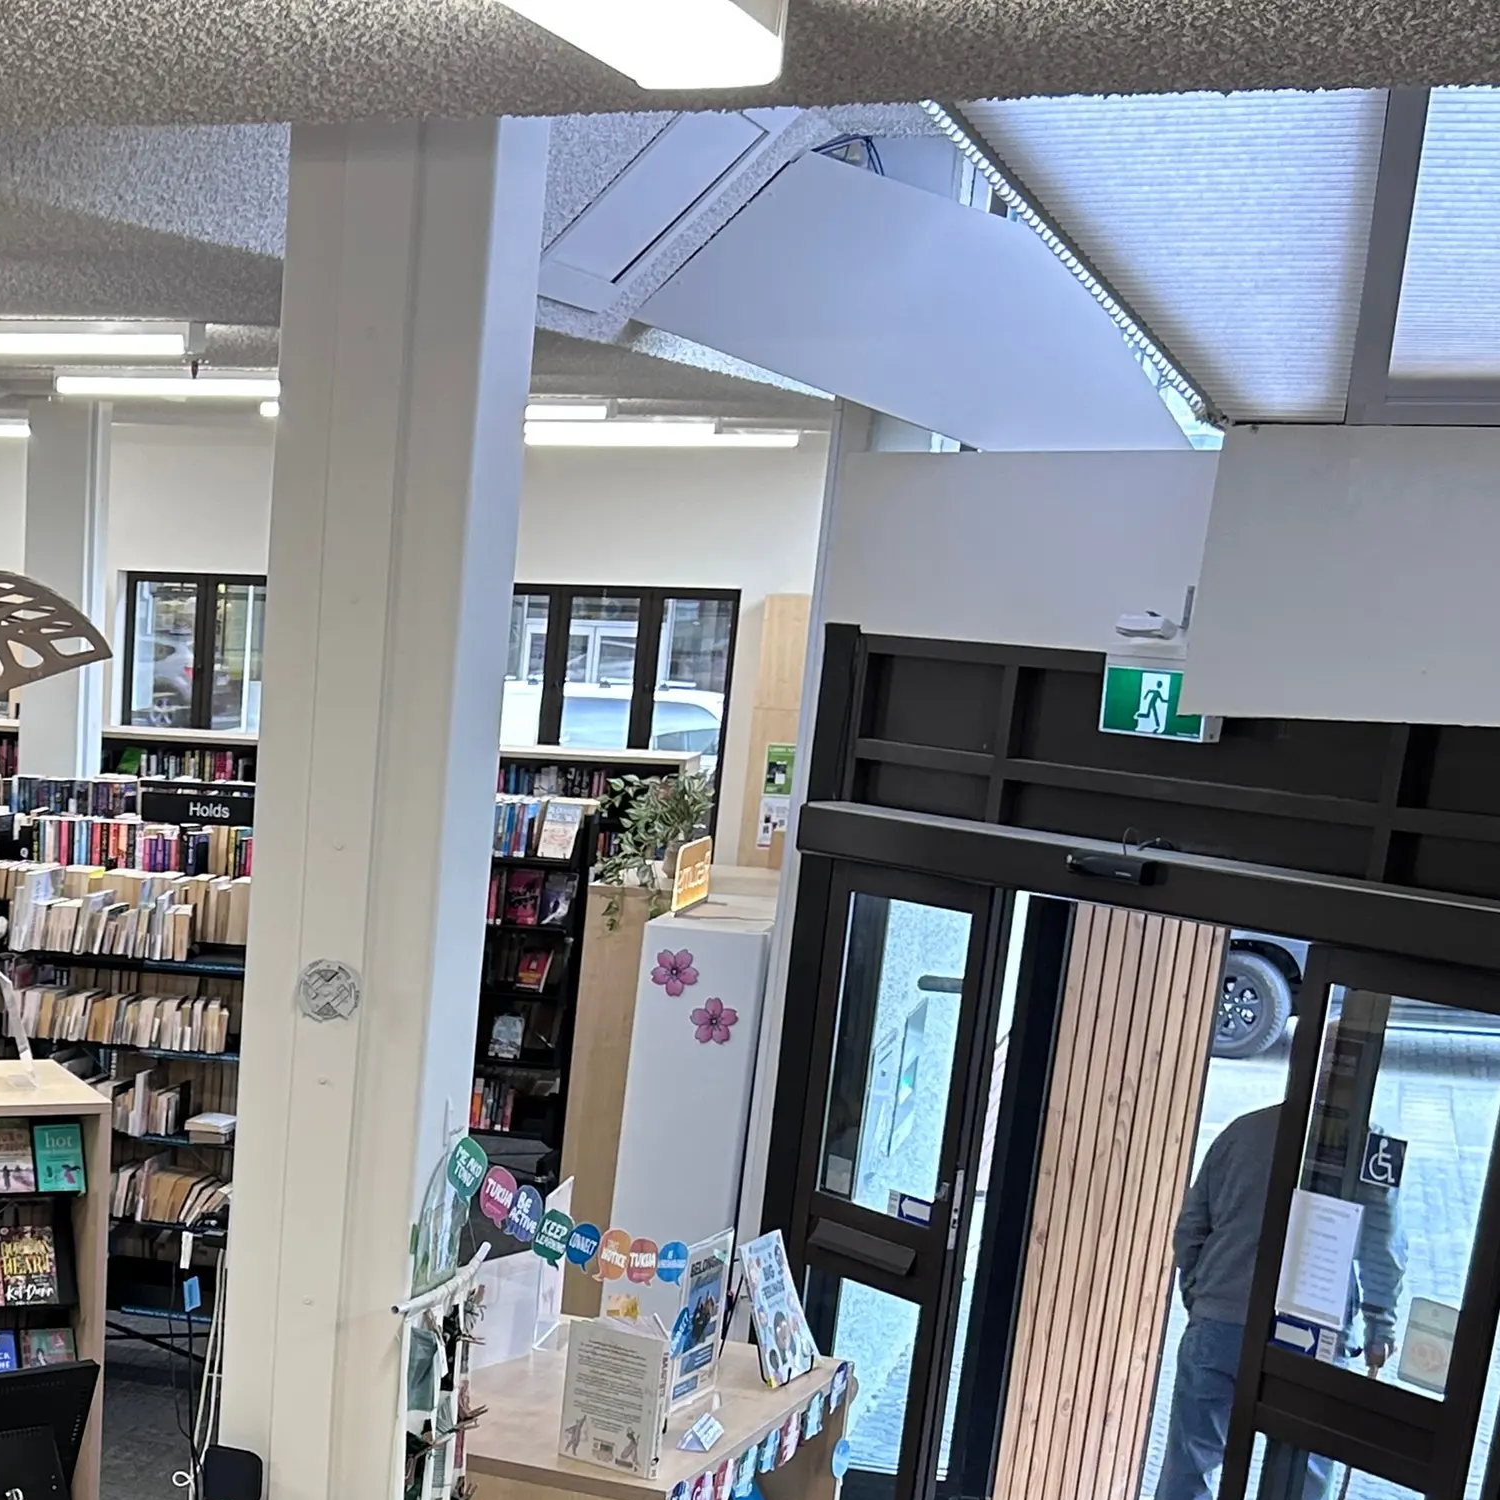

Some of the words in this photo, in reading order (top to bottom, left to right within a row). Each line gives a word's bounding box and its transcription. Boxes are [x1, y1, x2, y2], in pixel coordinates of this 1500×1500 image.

[189, 801, 230, 818] Holds
[45, 1131, 72, 1148] hot
[517, 1191, 533, 1214] BE
[509, 1205, 537, 1235] ACTIVE
[541, 1218, 568, 1240] KEEP
[568, 1231, 598, 1256] CONNECT
